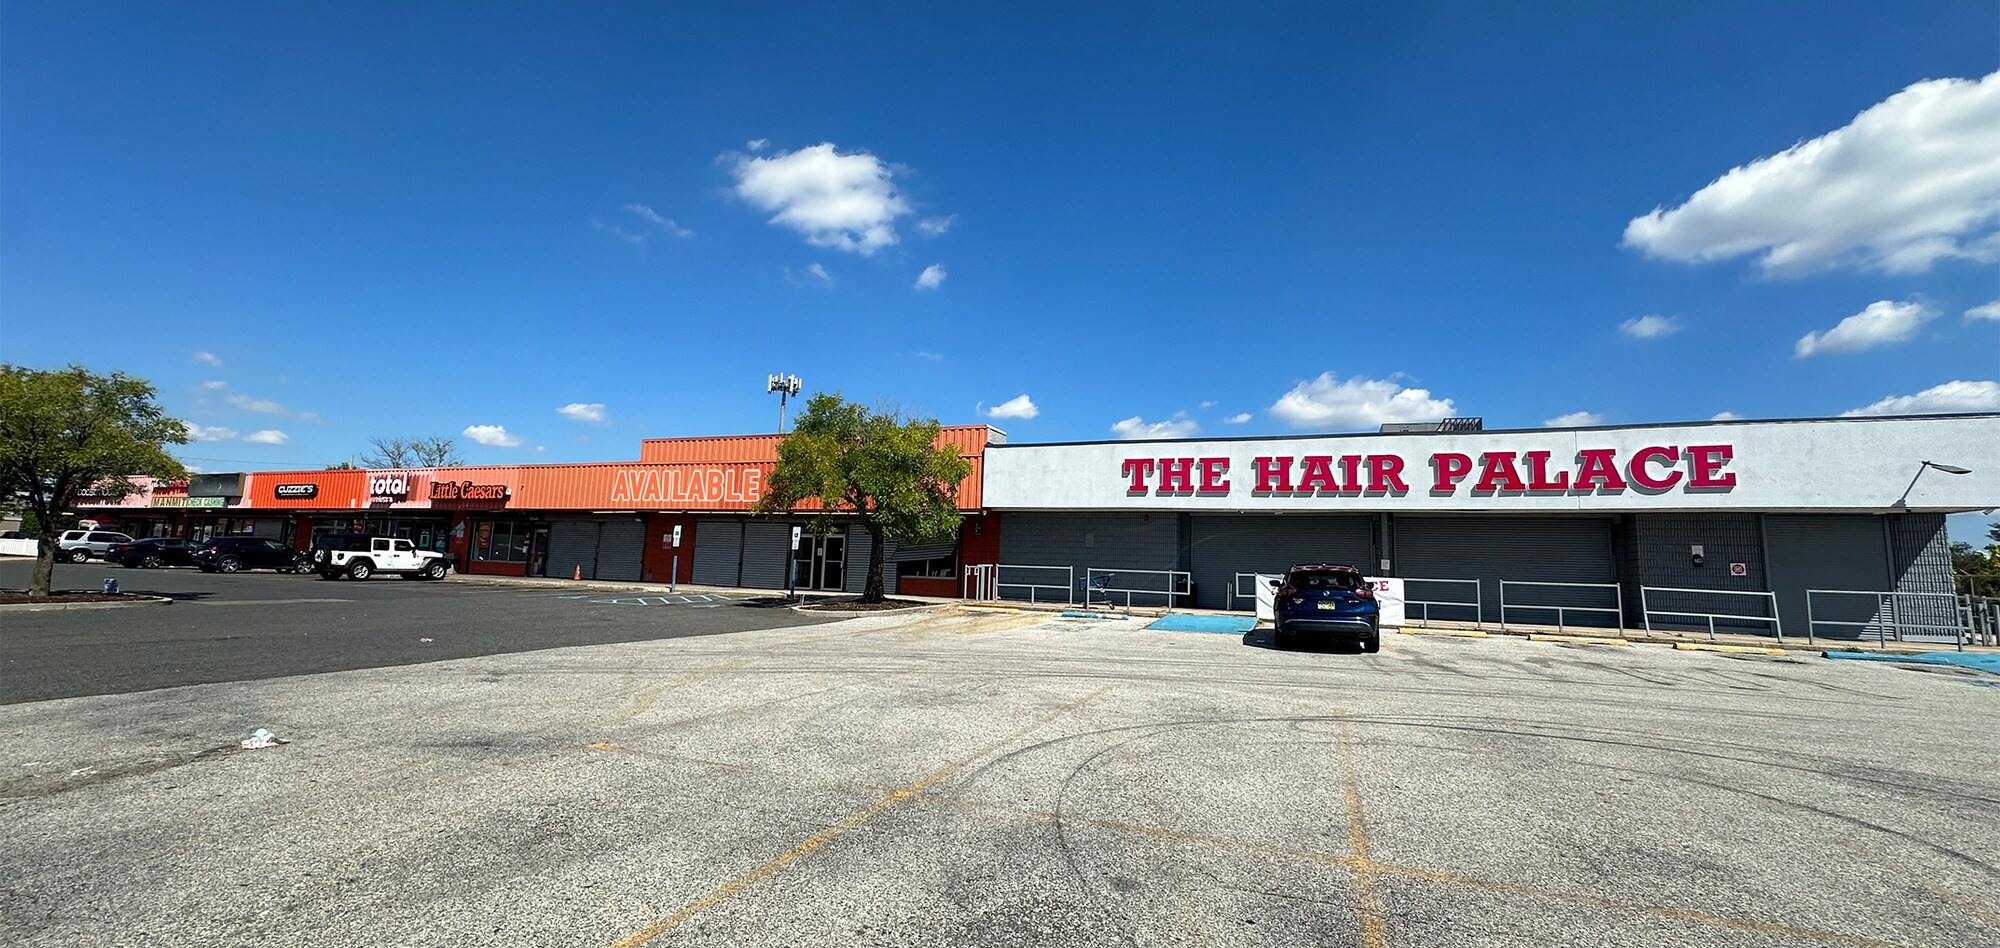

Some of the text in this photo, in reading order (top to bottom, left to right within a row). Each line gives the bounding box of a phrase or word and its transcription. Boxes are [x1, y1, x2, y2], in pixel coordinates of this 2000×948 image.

[611, 469, 761, 502] AVAILABLE
[1121, 444, 1737, 498] THE HAIR PALACE
[428, 481, 505, 499] Little Caesars
